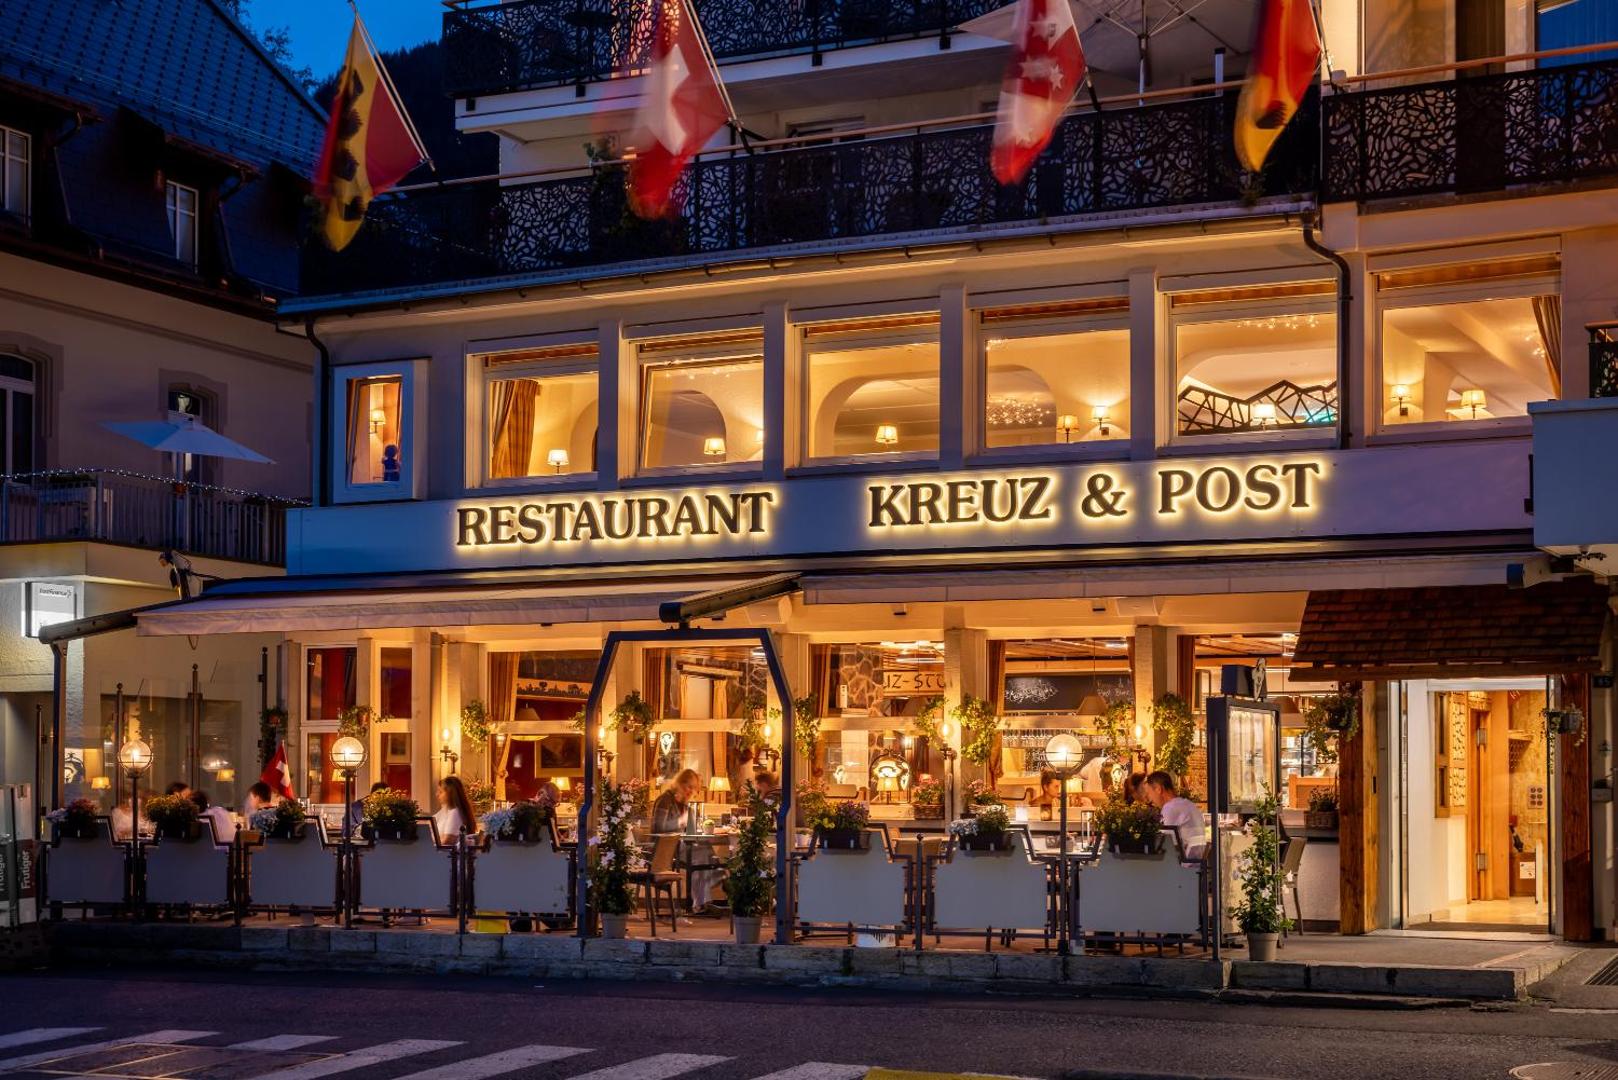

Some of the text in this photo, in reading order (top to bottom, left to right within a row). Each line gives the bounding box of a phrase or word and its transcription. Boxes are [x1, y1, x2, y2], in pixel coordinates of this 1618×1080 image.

[456, 463, 1320, 546] RESTAURANT KREUZ & POST
[21, 850, 31, 889] Frutiger
